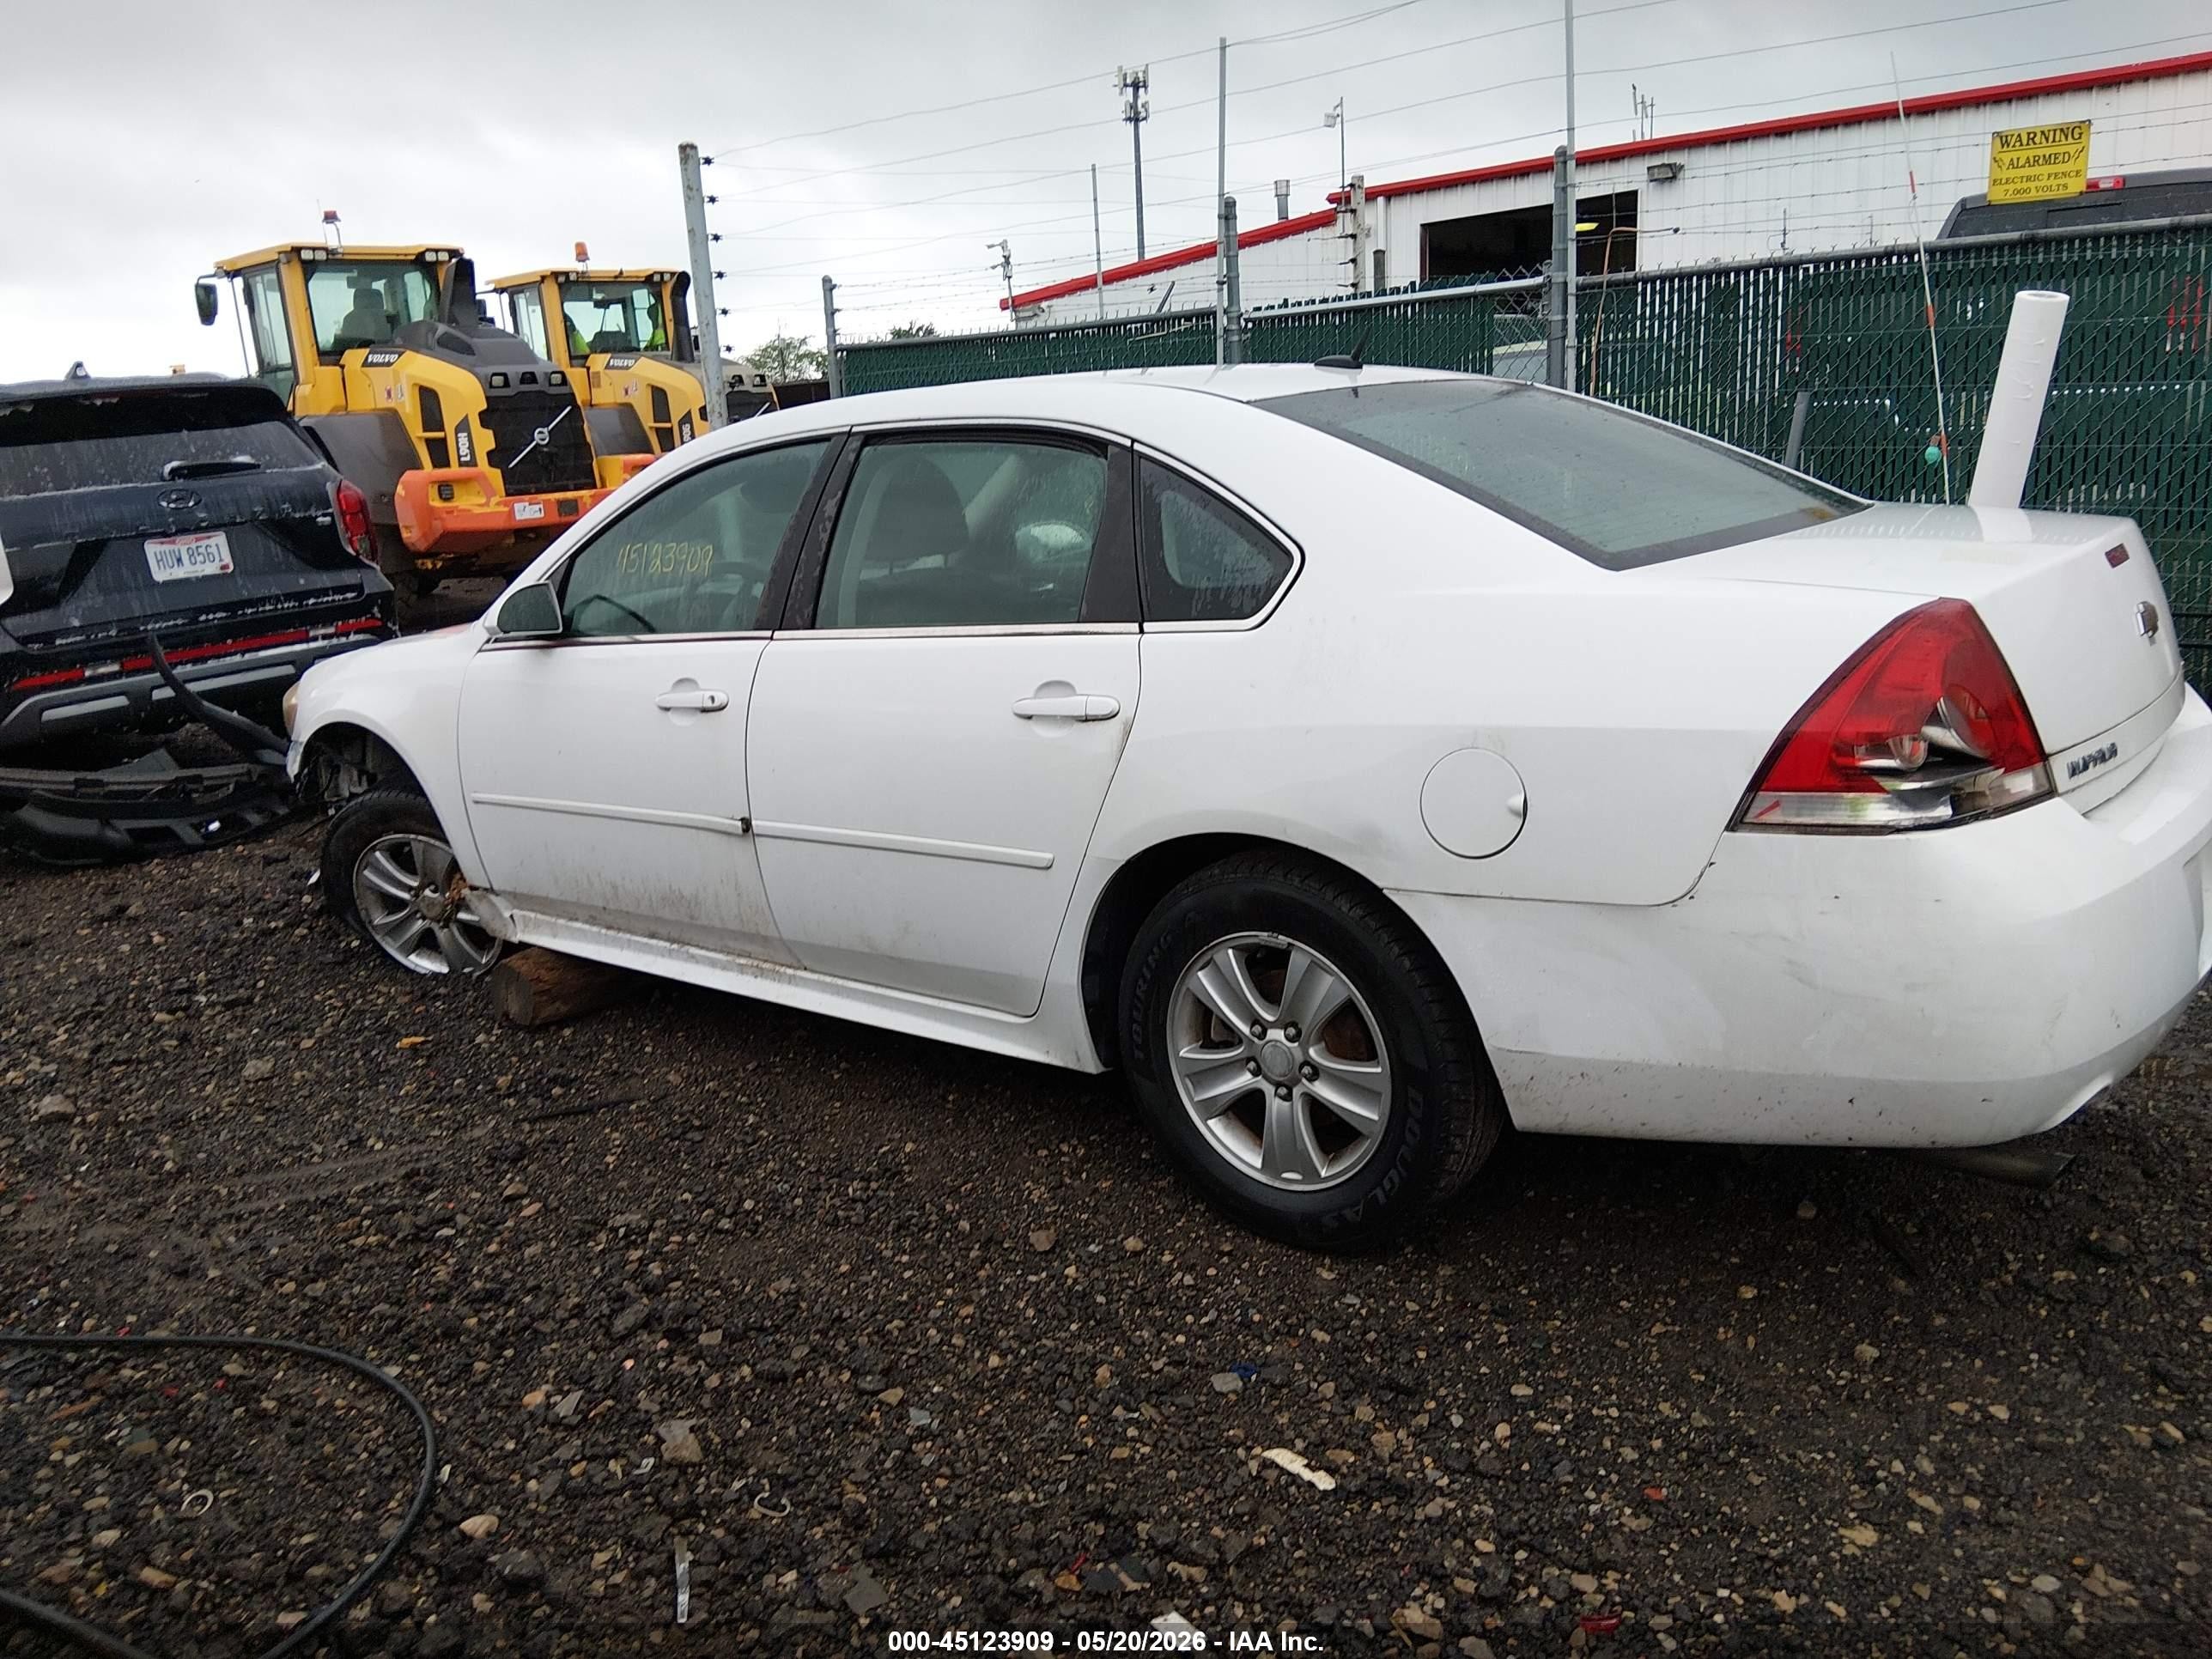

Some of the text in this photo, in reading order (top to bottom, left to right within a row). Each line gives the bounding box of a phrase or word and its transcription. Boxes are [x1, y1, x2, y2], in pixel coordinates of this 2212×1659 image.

[1998, 125, 2083, 149] WARNING
[2006, 151, 2071, 170] ALARMED
[1992, 169, 2082, 186] ELECTRIC FENCE
[2035, 183, 2069, 193] VOLTS
[367, 353, 398, 362] VOLVO
[609, 358, 635, 367] VOLVO
[458, 433, 471, 462] L90H
[155, 544, 224, 571] HUW 8561
